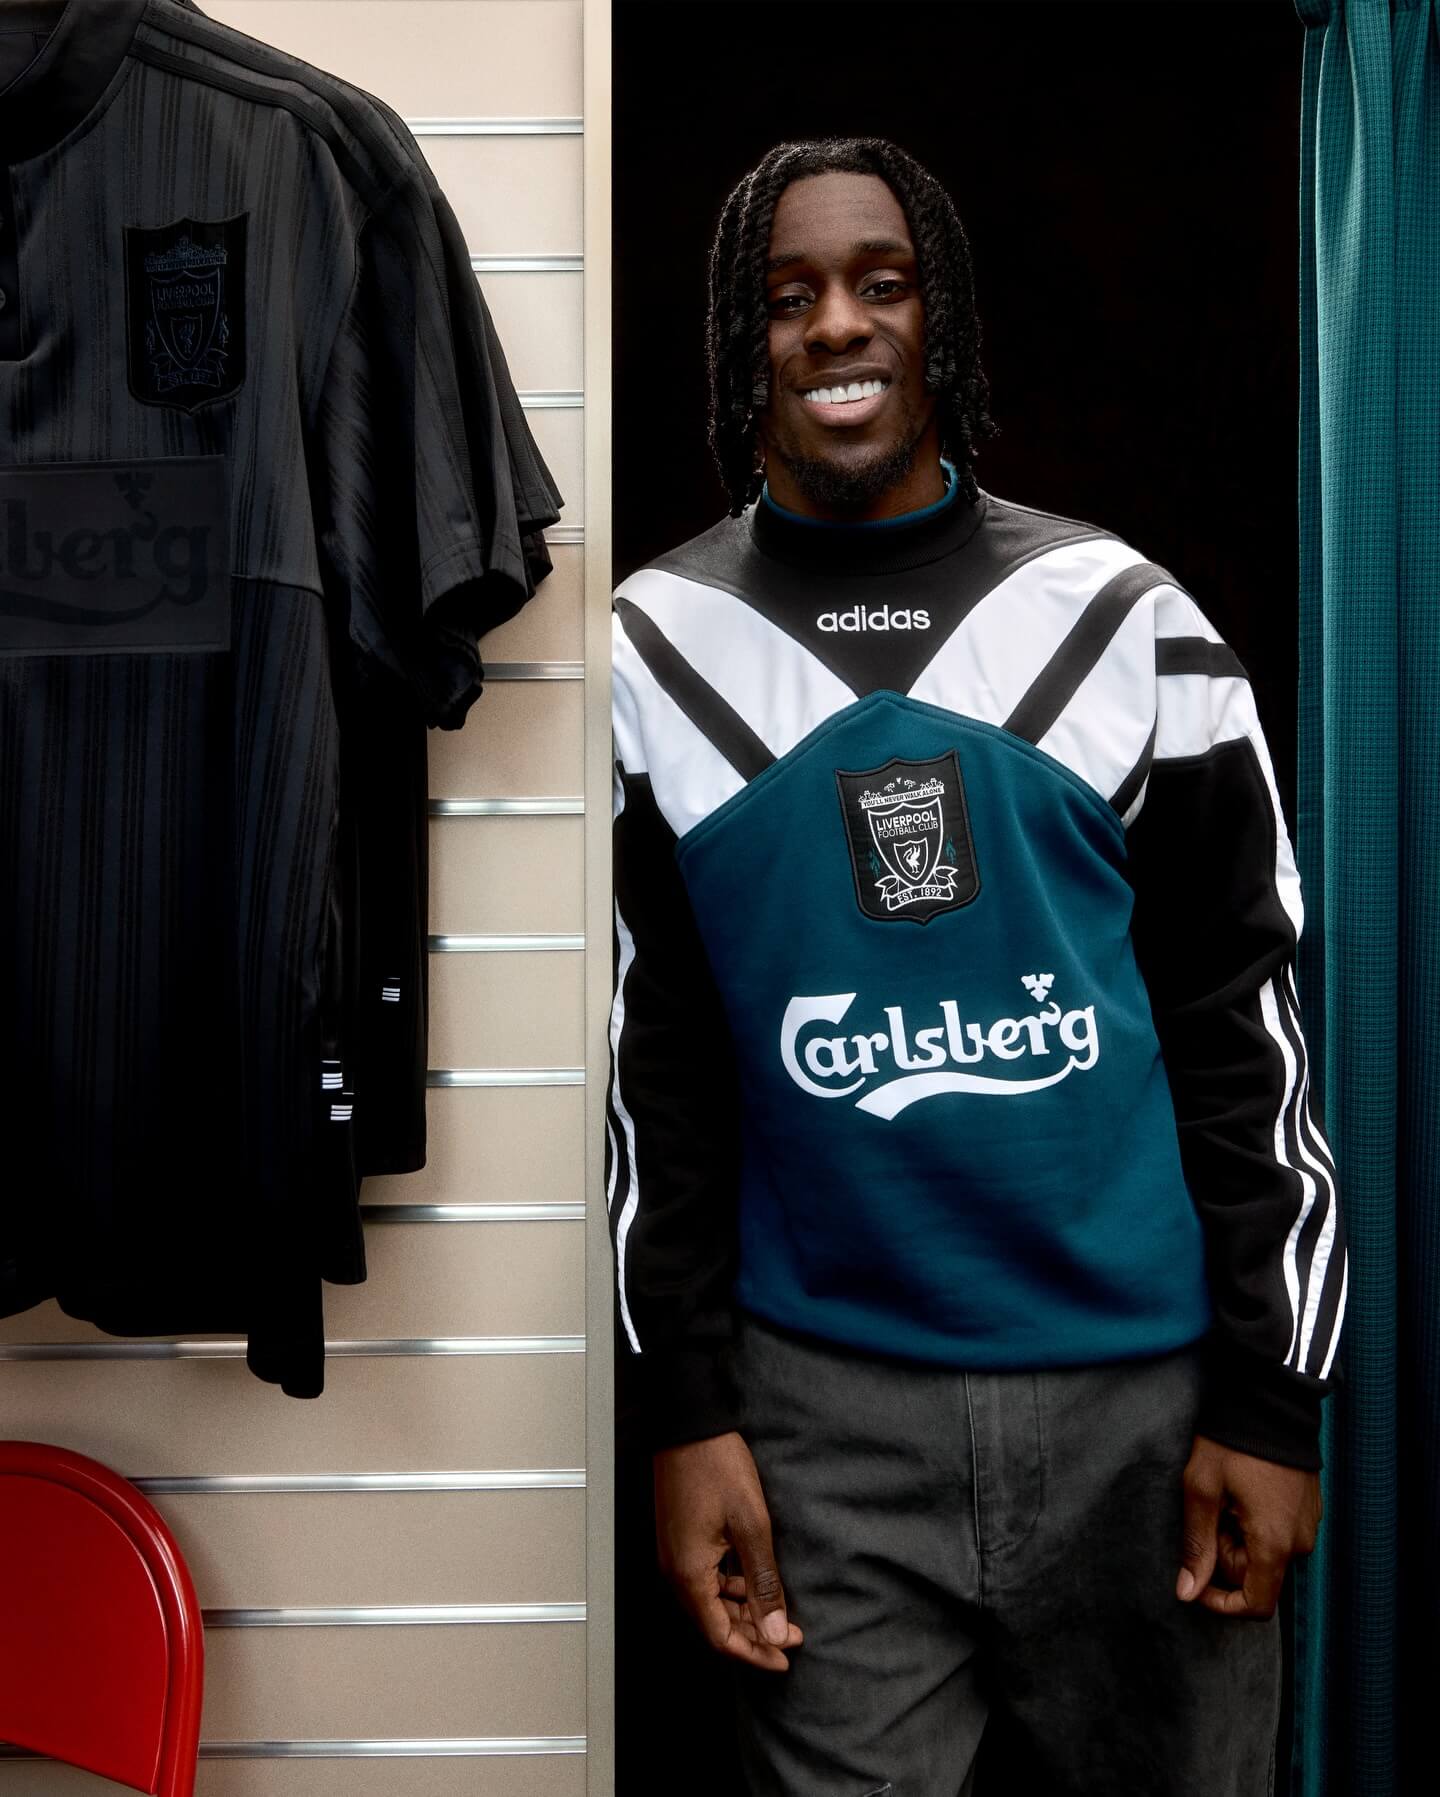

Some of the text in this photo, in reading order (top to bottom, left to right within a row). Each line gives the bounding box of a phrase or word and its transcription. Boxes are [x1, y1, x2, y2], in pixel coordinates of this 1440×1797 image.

[0, 497, 211, 606] berg
[816, 604, 931, 632] adidas
[884, 794, 904, 803] NEVER
[904, 790, 921, 799] WALK
[921, 787, 942, 797] ALONE
[876, 810, 937, 831] LIVERPOOL
[878, 821, 938, 838] FOOTBALL CLUB
[897, 887, 942, 903] EST. 1892
[780, 992, 1100, 1099] Carlsberg
